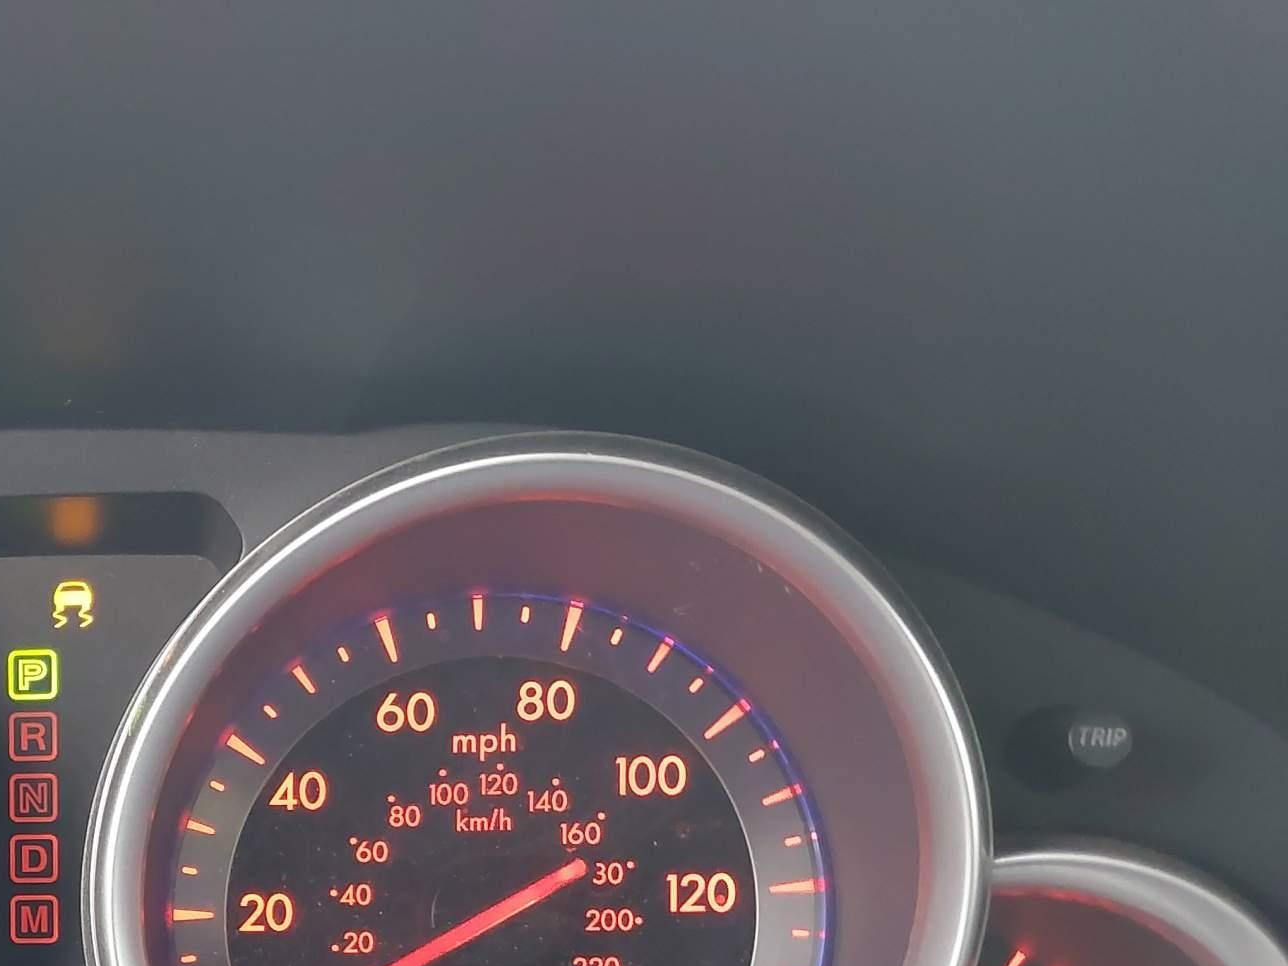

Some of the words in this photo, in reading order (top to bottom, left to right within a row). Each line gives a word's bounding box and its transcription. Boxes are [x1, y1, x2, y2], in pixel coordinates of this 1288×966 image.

[18, 660, 47, 690] P
[376, 692, 435, 732] 60
[516, 680, 576, 721] 80
[20, 721, 46, 751] R
[452, 723, 516, 761] mph
[1079, 726, 1128, 747] TRIP
[269, 771, 328, 811] 40
[480, 773, 518, 796] 120
[615, 756, 687, 797] 100
[21, 783, 47, 813] N
[429, 783, 469, 806] 100
[527, 790, 568, 813] 140
[389, 805, 421, 828] 80
[456, 808, 512, 832] km/h
[560, 822, 601, 845] 160
[22, 845, 48, 874] D
[356, 841, 389, 863] 60
[340, 884, 371, 906] 40
[666, 873, 737, 913] 120
[22, 905, 48, 935] M
[239, 893, 293, 932] 20
[585, 909, 634, 931] 200
[343, 931, 374, 953] 20
